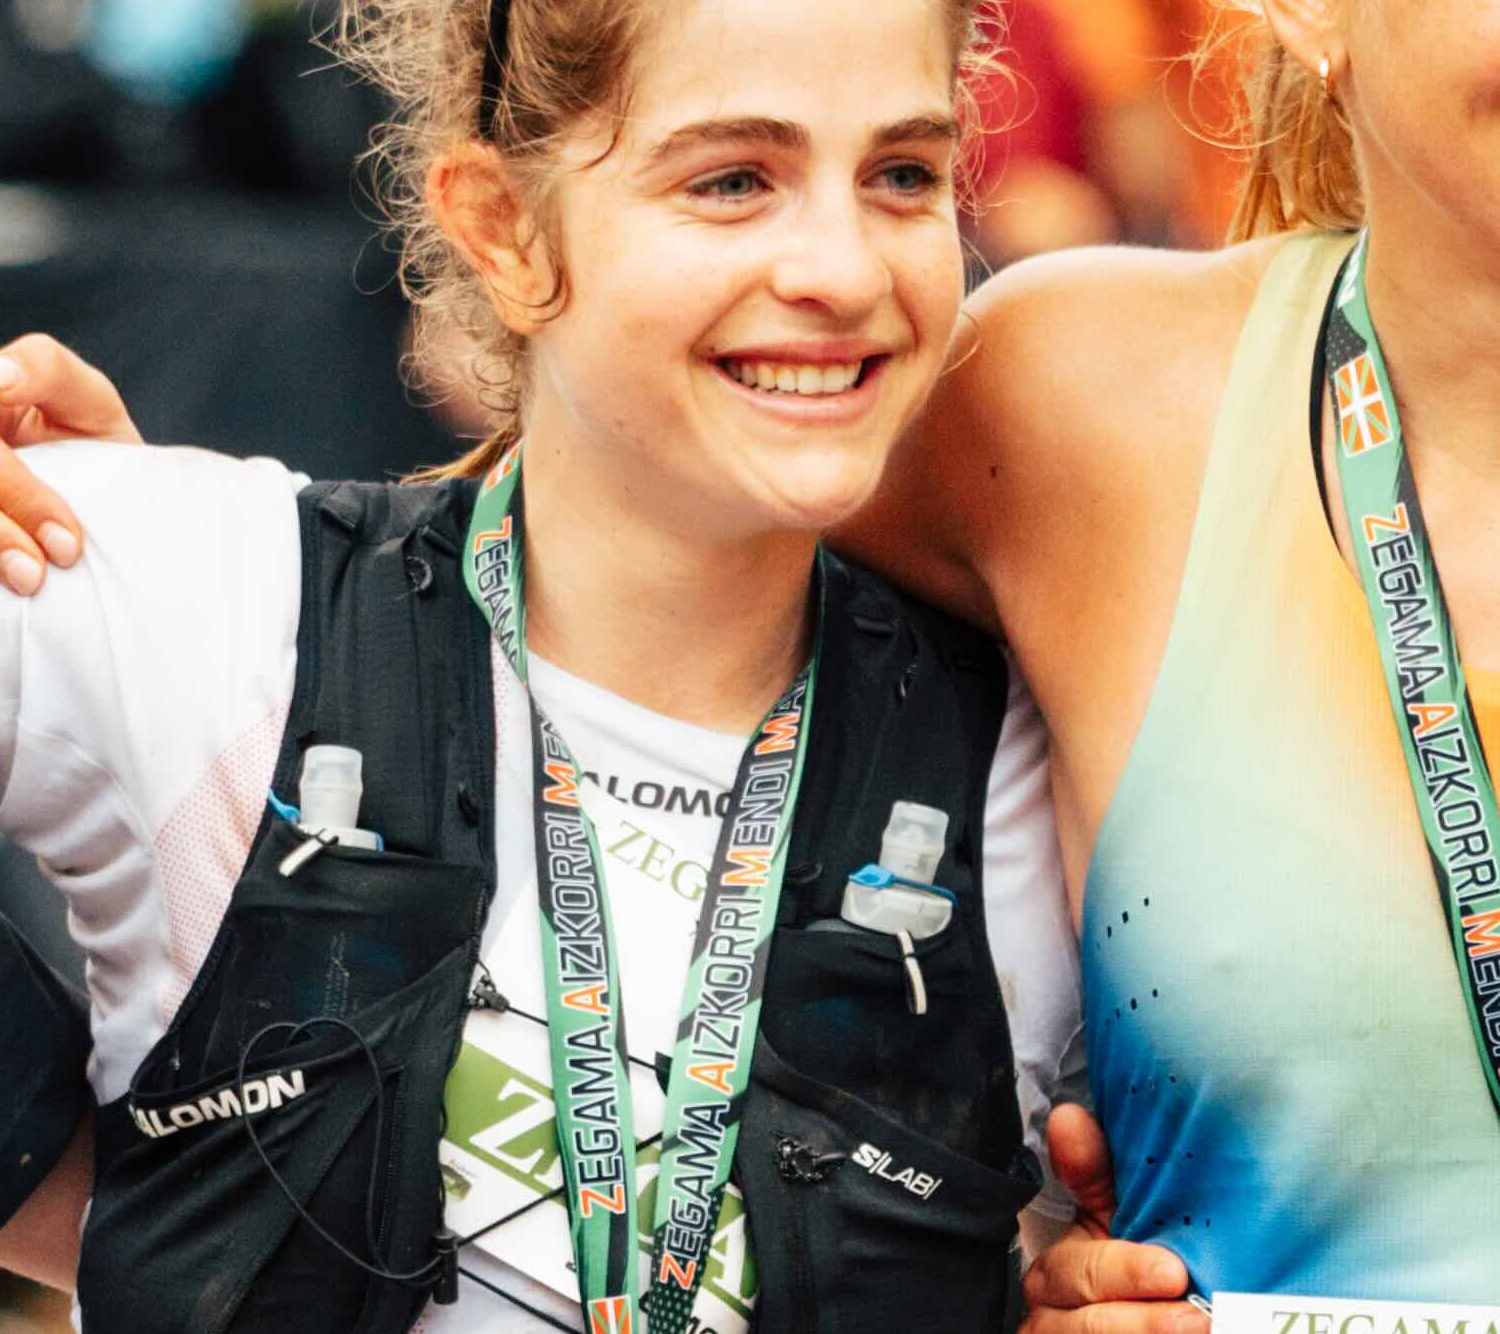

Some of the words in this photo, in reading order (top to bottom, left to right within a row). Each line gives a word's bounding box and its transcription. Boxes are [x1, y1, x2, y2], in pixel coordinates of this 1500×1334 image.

[1362, 502, 1446, 697] ZEGAMA
[1407, 700, 1500, 907] AIZKORRI
[543, 809, 610, 1015] AIZKORRI
[719, 759, 793, 887] MENDI
[687, 894, 764, 1095] AIZKORRI
[563, 1021, 628, 1219] ZEGAMA
[658, 1100, 731, 1291] ZEGAMA
